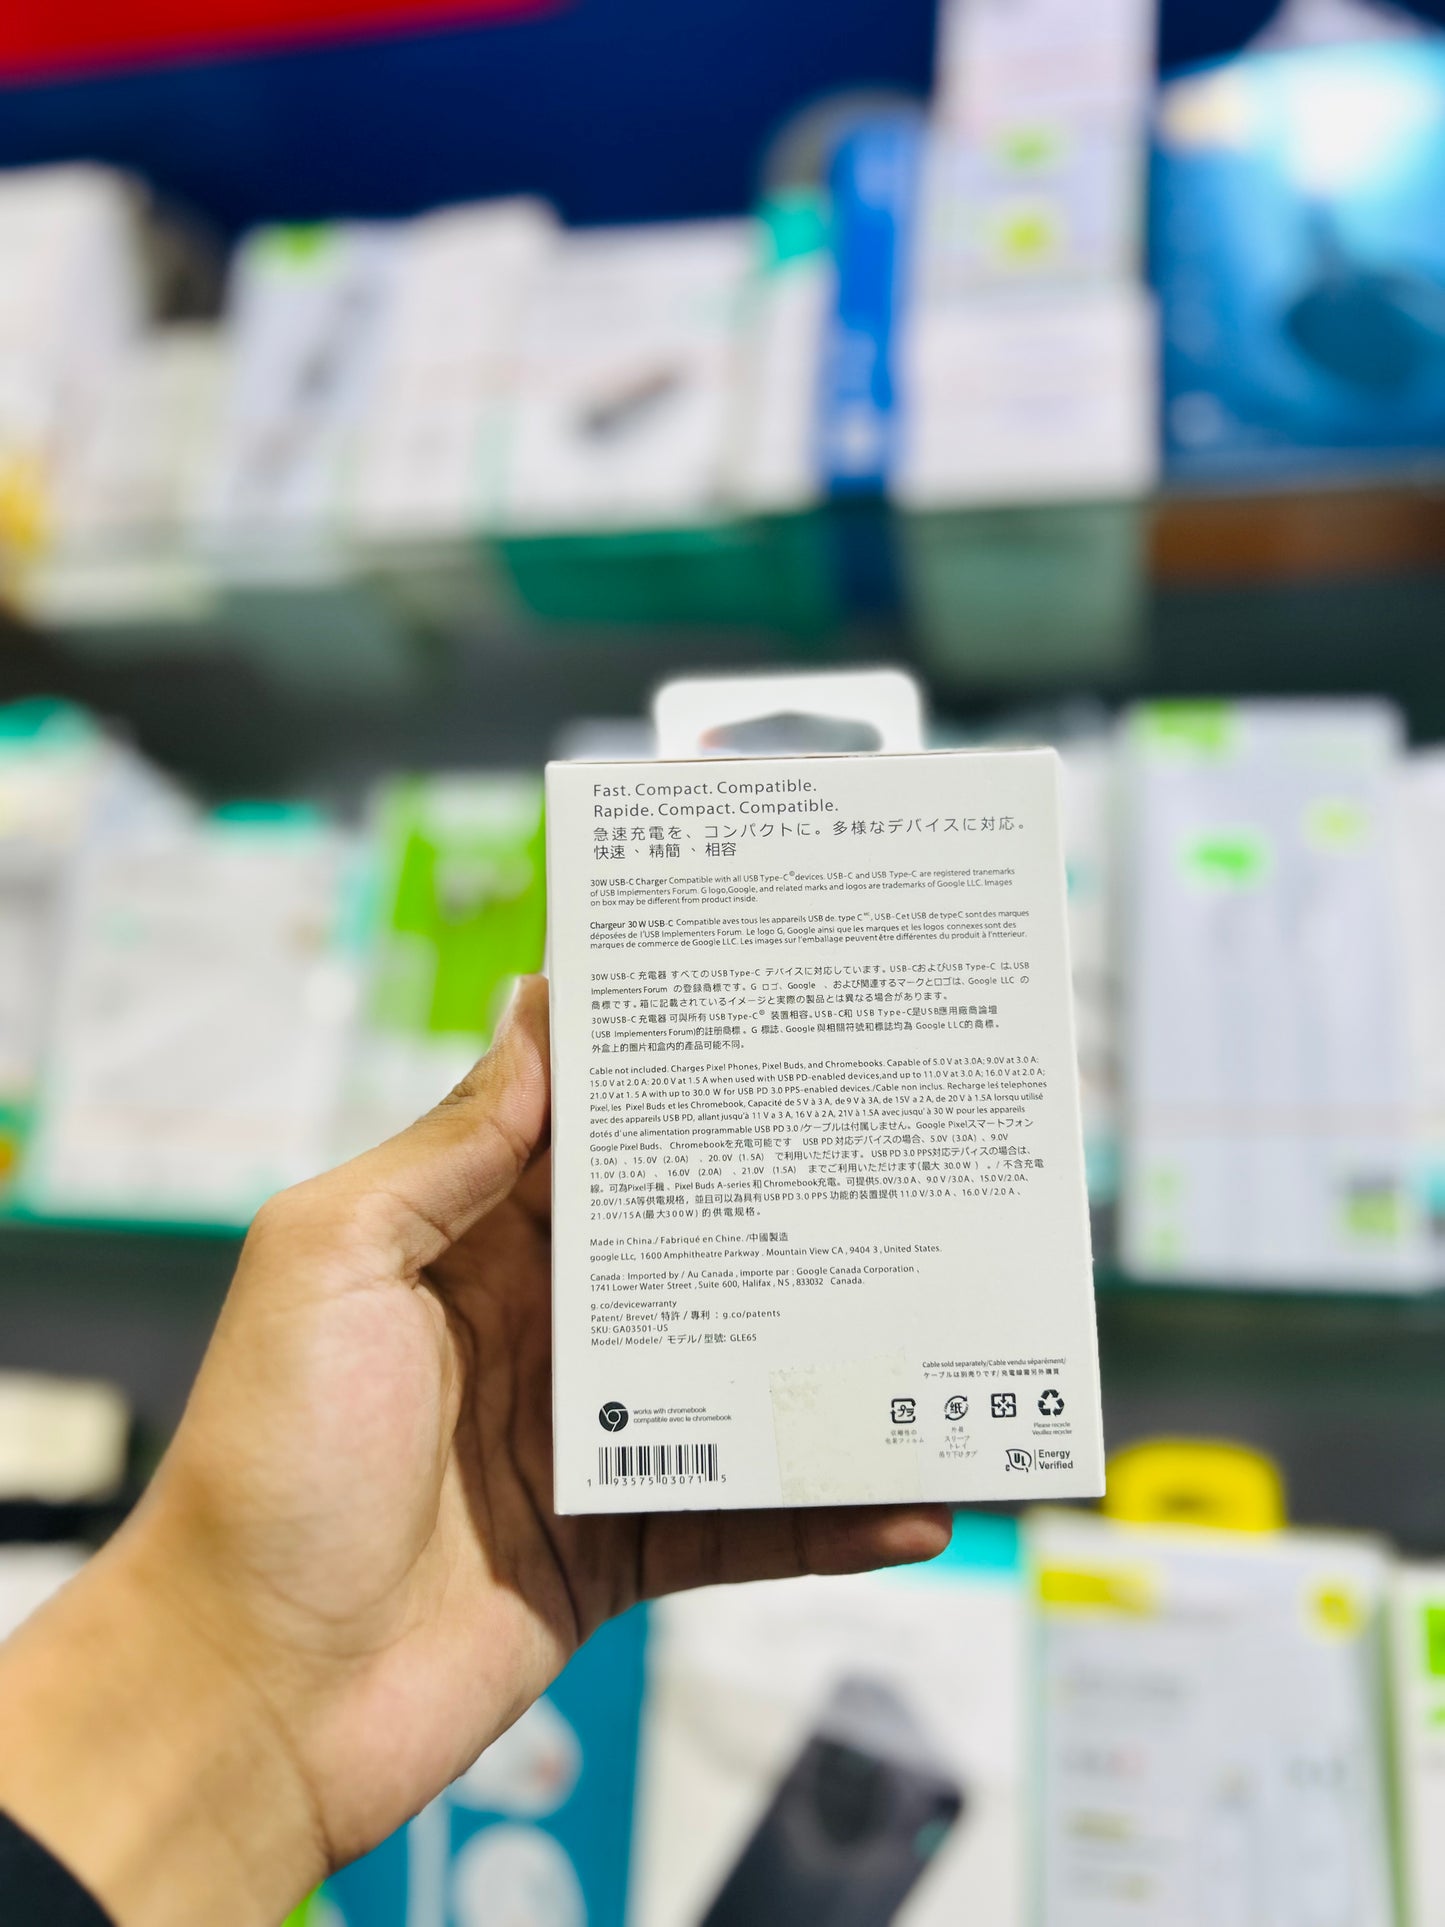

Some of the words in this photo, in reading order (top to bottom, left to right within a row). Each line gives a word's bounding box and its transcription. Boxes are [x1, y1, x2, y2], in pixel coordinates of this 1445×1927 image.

[594, 785, 630, 795] Fast.
[635, 783, 712, 796] Compact.
[717, 778, 816, 793] Compatible.
[594, 804, 653, 820] Rapide.
[658, 803, 735, 817] Compact.
[740, 799, 838, 815] Compatible.
[591, 879, 607, 887] 30W
[609, 878, 634, 886] USB-C
[636, 877, 667, 887] Charger
[669, 876, 713, 885] Compatible
[715, 875, 731, 883] with
[743, 874, 758, 882] USB
[827, 872, 852, 881] USB-C
[872, 870, 887, 879] USB
[889, 870, 916, 880] Type-C
[933, 868, 970, 879] registered
[600, 889, 615, 897] USB
[617, 885, 670, 897] Implementers
[759, 885, 774, 893] and
[776, 884, 802, 892] related
[829, 882, 844, 891] and
[846, 882, 867, 891] logos
[882, 880, 925, 889] trademarks
[937, 879, 965, 889] Google
[967, 879, 983, 887] LLC.
[985, 879, 1012, 888] Images
[602, 898, 616, 906] box
[647, 897, 680, 905] different
[682, 895, 700, 904] from
[702, 895, 731, 904] product
[590, 921, 625, 930] Chargeur
[676, 918, 720, 928] Compatible
[772, 915, 806, 925] appareils
[911, 911, 926, 921] USB
[998, 910, 1029, 920] marques
[590, 929, 626, 940] déposées
[640, 929, 660, 939] l'USB
[947, 923, 984, 931] connexes
[590, 942, 624, 950] marques
[692, 939, 720, 947] Google
[723, 937, 738, 945] LLC.
[755, 938, 783, 946] images
[798, 935, 843, 944] l'emballage
[845, 934, 877, 943] peuvent
[879, 933, 894, 941] être
[896, 932, 937, 940] différentes
[951, 931, 980, 940] produit
[591, 987, 642, 996] Implementers
[644, 985, 667, 993] Forum
[590, 1066, 612, 1075] Cable
[631, 1065, 669, 1074] included.
[671, 1065, 704, 1074] Charges
[707, 1063, 725, 1071] Pixel
[728, 1063, 760, 1071] Phones,
[762, 1062, 781, 1070] Pixel
[784, 1061, 806, 1070] Buds,
[808, 1061, 823, 1069] and
[825, 1059, 885, 1068] Chromebooks.
[887, 1058, 920, 1067] Capable
[649, 1090, 667, 1098] with
[738, 1087, 753, 1095] USB
[785, 1084, 838, 1094] PPS-enabled
[920, 1083, 944, 1091] inclus.
[947, 1081, 985, 1090] Recharge
[1001, 1081, 1047, 1089] telephones
[590, 1253, 619, 1262] google
[641, 1251, 662, 1260] 1600
[664, 1250, 722, 1260] Amphitheatre
[725, 1249, 759, 1258] Parkway
[767, 1248, 807, 1256] Mountain
[832, 1246, 843, 1255] CA
[884, 1244, 911, 1253] United
[915, 1244, 942, 1252] States.
[590, 1272, 620, 1281] Canada
[628, 1271, 666, 1281] Imported
[669, 1271, 679, 1280] by
[688, 1270, 698, 1278] Au
[701, 1269, 733, 1278] Canada
[740, 1269, 773, 1278] importe
[797, 1267, 827, 1276] Google
[830, 1266, 861, 1275] Canada
[863, 1265, 914, 1274] Corporation
[591, 1283, 609, 1292] 1741
[613, 1283, 637, 1291] Lower
[639, 1282, 664, 1291] Water
[722, 1280, 739, 1288] 600,
[743, 1278, 770, 1287] Halifax
[796, 1277, 823, 1286] 833032
[831, 1276, 864, 1285] Canada.
[591, 1325, 610, 1334] SKU:
[613, 1324, 668, 1333] GA03501-US
[633, 1416, 668, 1424] compatible
[693, 1414, 732, 1422] chromebook
[1038, 1450, 1071, 1460] Energy
[1038, 1460, 1074, 1470] Verified
